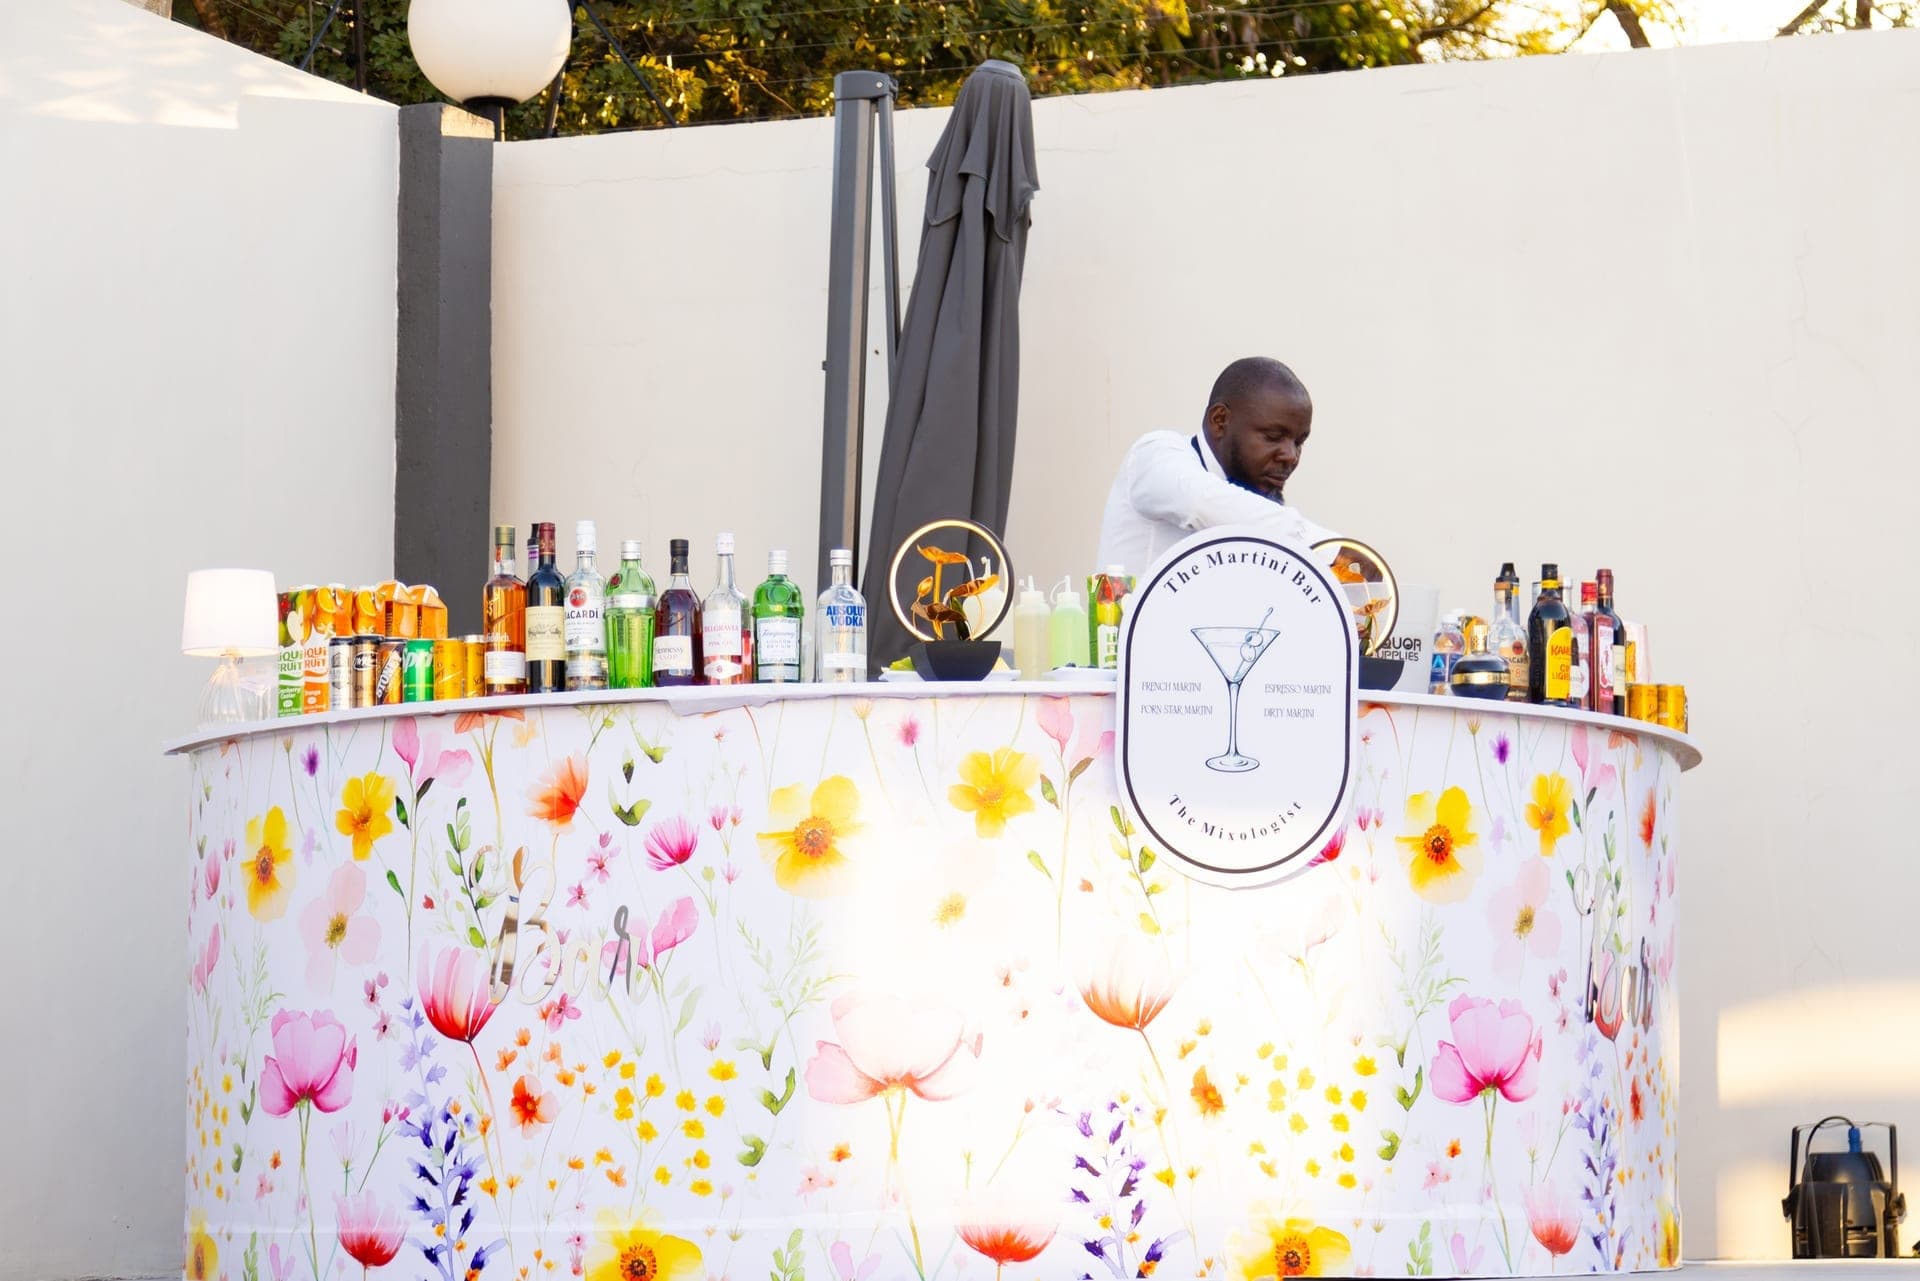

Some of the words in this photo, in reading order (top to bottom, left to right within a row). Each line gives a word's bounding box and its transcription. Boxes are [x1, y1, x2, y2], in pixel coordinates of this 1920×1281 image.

[1164, 564, 1200, 594] The
[1206, 550, 1289, 575] Martini
[1291, 570, 1321, 604] Bar
[831, 615, 863, 627] VODKA
[1380, 636, 1421, 652] QUOR
[1377, 650, 1419, 662] UPPLIES
[1141, 681, 1171, 692] FRENCH
[1173, 681, 1202, 693] MARTINI
[1264, 683, 1301, 694] ESPRESSO
[1303, 684, 1332, 695] MARTINI
[1164, 704, 1182, 714] STAR
[1184, 705, 1213, 715] MARTINI
[1263, 707, 1283, 718] DIRTY
[1286, 708, 1315, 719] MARTINI
[1169, 794, 1196, 826] The
[1201, 802, 1301, 841] Mixologist
[468, 844, 653, 1005] Bar
